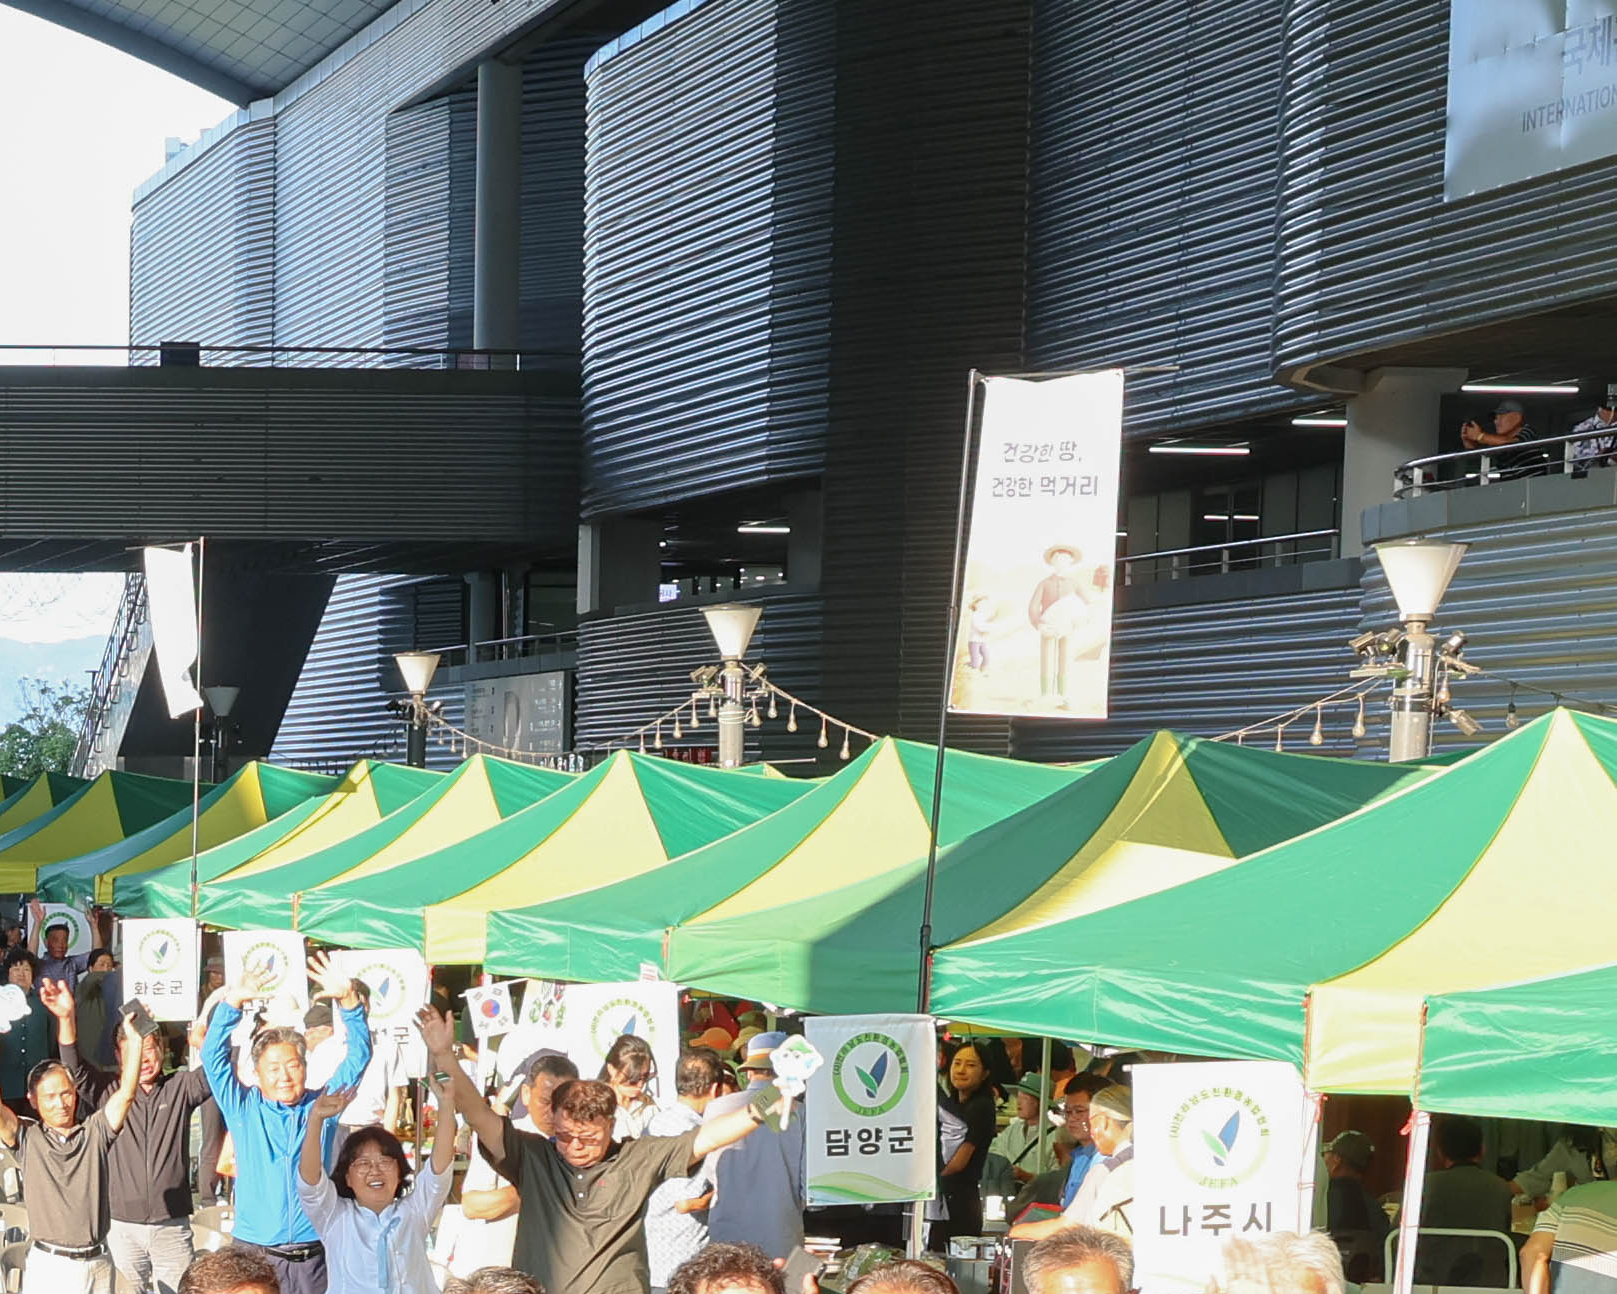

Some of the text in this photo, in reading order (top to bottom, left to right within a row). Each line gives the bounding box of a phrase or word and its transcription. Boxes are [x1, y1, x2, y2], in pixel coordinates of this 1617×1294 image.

[1003, 442, 1054, 463] 건강한
[992, 475, 1099, 498] 건강한 먹거리
[134, 980, 183, 995] 화순군
[825, 1126, 914, 1157] 담양군
[1159, 1201, 1272, 1236] 나주시
